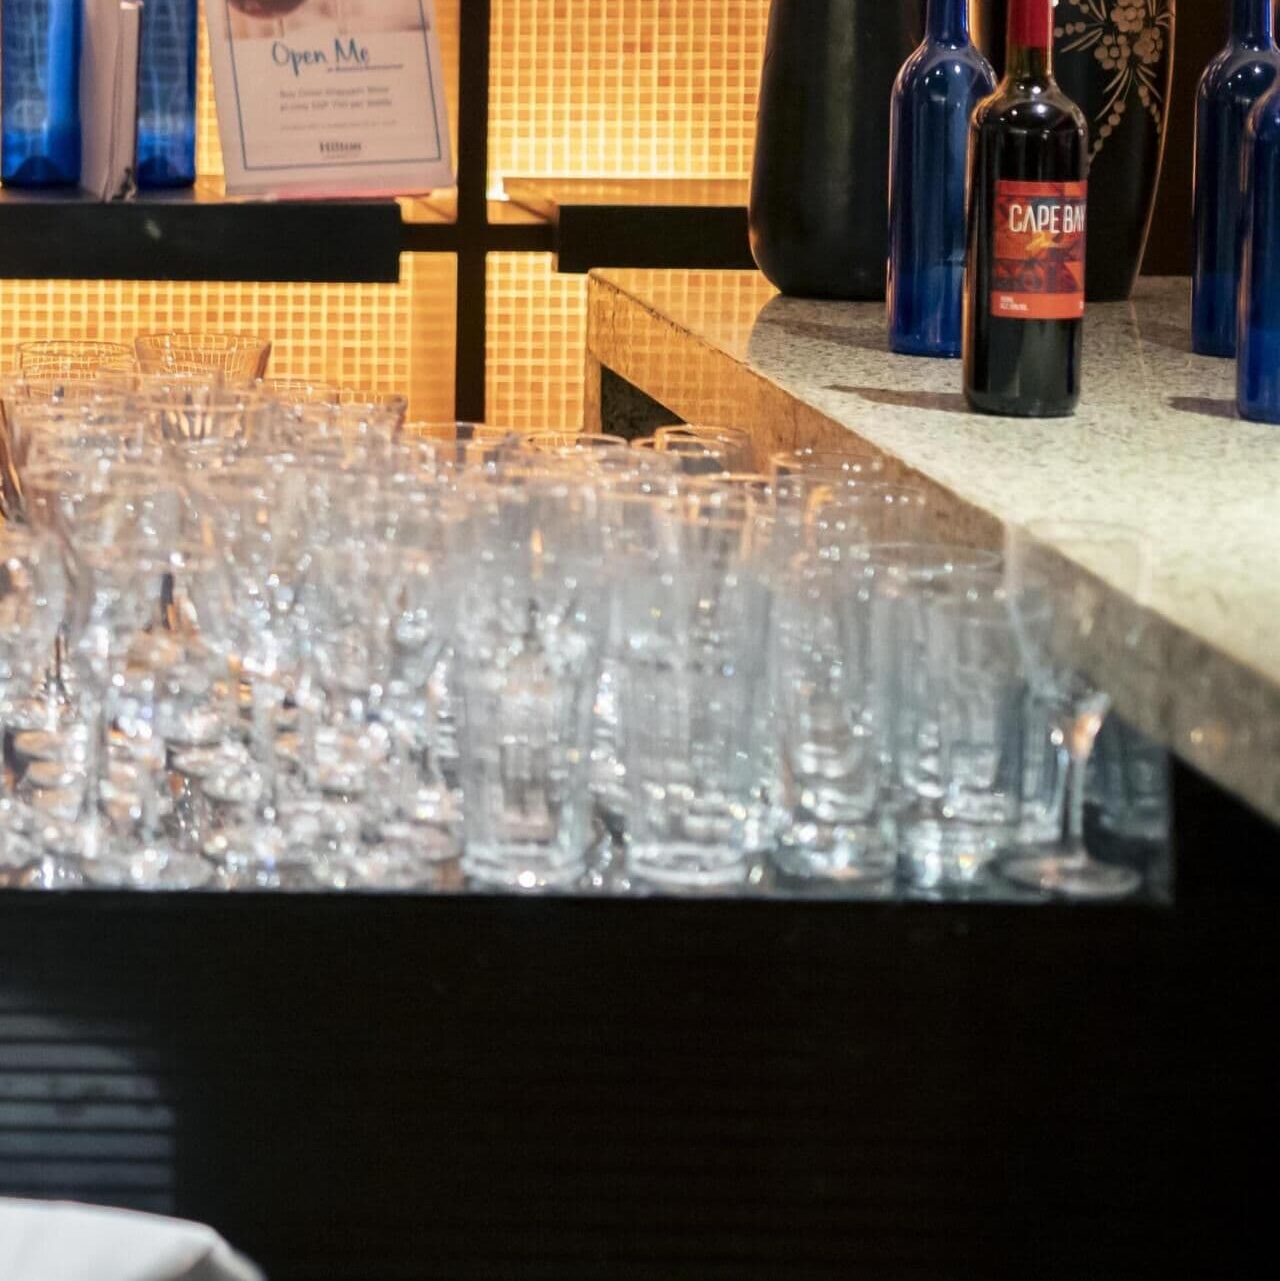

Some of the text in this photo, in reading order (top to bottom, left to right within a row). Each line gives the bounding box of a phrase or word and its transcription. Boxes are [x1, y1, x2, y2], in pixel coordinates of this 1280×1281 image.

[271, 37, 369, 77] Open Me
[1009, 204, 1061, 234] CAPE
